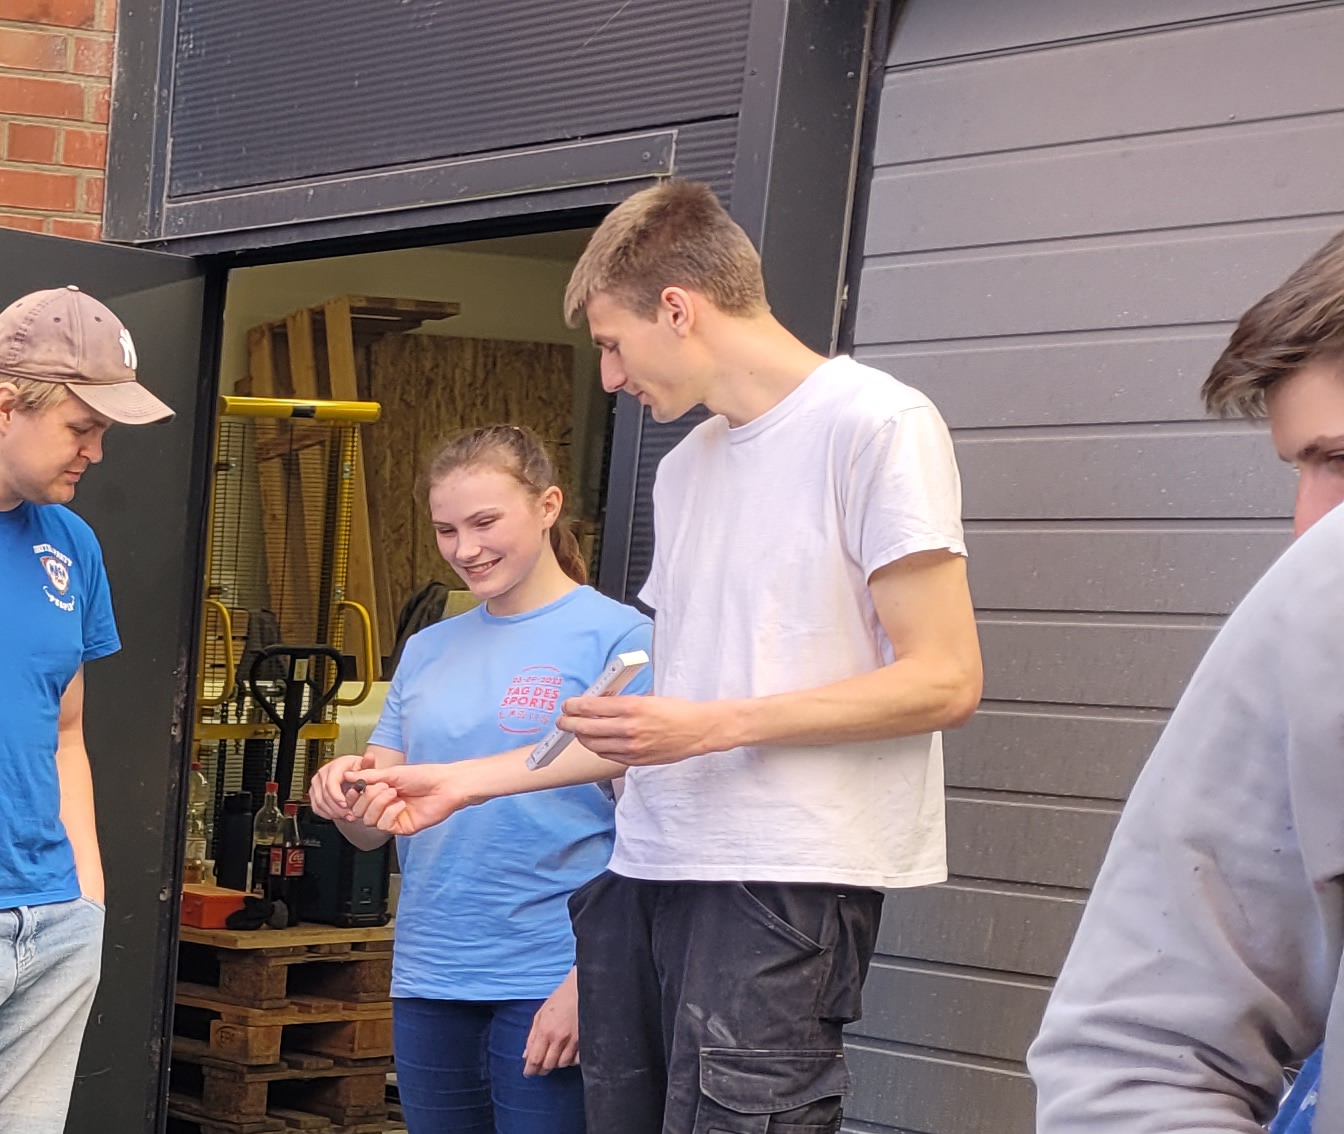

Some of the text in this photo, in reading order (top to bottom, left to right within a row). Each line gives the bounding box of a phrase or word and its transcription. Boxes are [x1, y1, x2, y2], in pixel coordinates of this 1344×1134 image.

[508, 686, 559, 700] TAG DES
[501, 696, 555, 711] SPORTS
